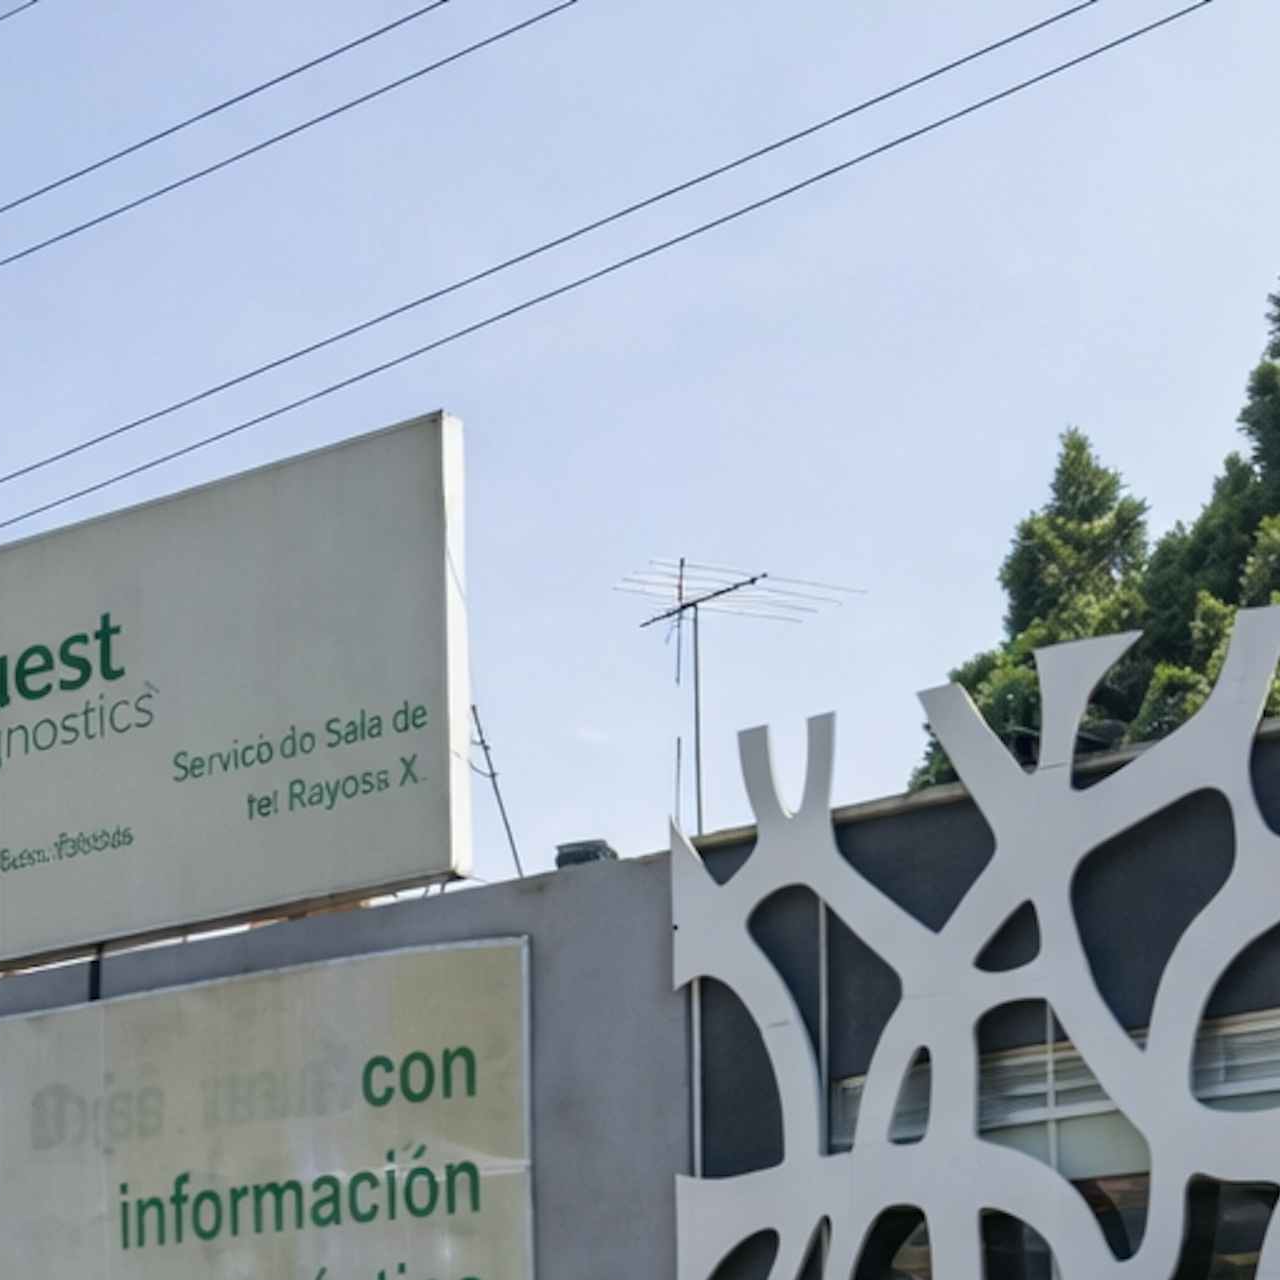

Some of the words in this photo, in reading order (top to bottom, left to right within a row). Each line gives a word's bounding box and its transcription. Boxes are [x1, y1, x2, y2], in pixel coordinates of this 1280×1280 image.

[324, 708, 382, 749] Sala
[392, 700, 428, 734] de
[361, 1044, 477, 1107] con
[120, 1143, 481, 1251] información
